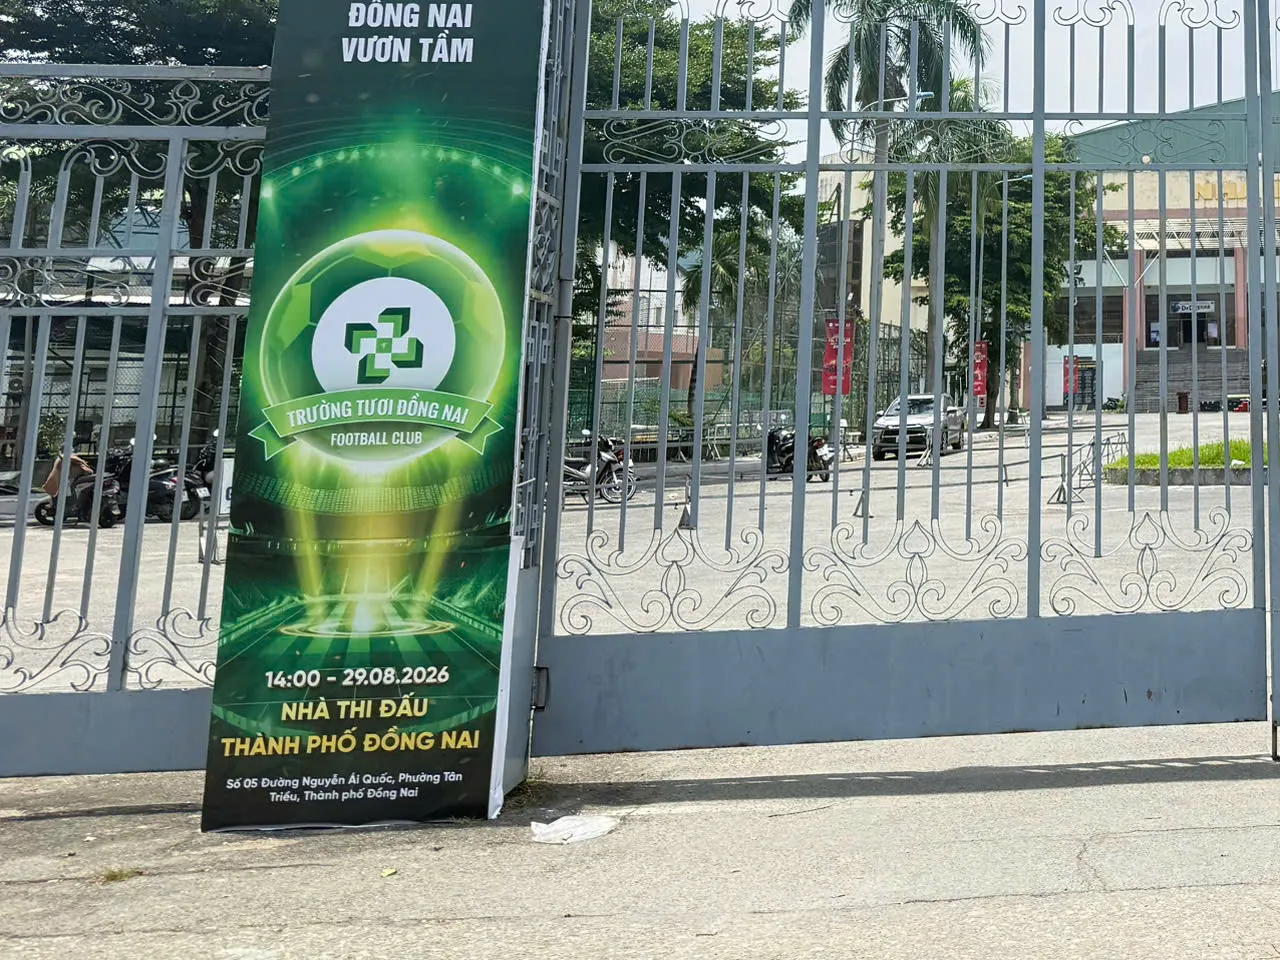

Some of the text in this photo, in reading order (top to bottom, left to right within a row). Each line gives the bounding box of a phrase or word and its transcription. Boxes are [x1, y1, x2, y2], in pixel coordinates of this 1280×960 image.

[427, 4, 472, 28] NAI
[342, 29, 474, 63] VƯƠN TẦM
[287, 393, 468, 428] TRƯỜNG TƯƠI ĐỒNG NAI
[330, 432, 422, 446] FOOTBALL CLUB
[265, 670, 320, 688] 14:00
[342, 666, 449, 686] 29.08.2026
[281, 692, 428, 720] NHÀ THI ĐẤU
[221, 726, 480, 757] THÀNH PHỐ ĐỒNG NAI
[226, 777, 242, 789] Số
[244, 778, 258, 788] 05
[261, 776, 299, 792] Đường
[348, 771, 360, 784] Ái
[362, 772, 395, 786] Quốc,
[399, 771, 441, 786] Phường
[444, 771, 462, 782] Tân
[303, 789, 339, 801] Thành
[342, 788, 365, 803] phố
[400, 787, 418, 798] Nai
